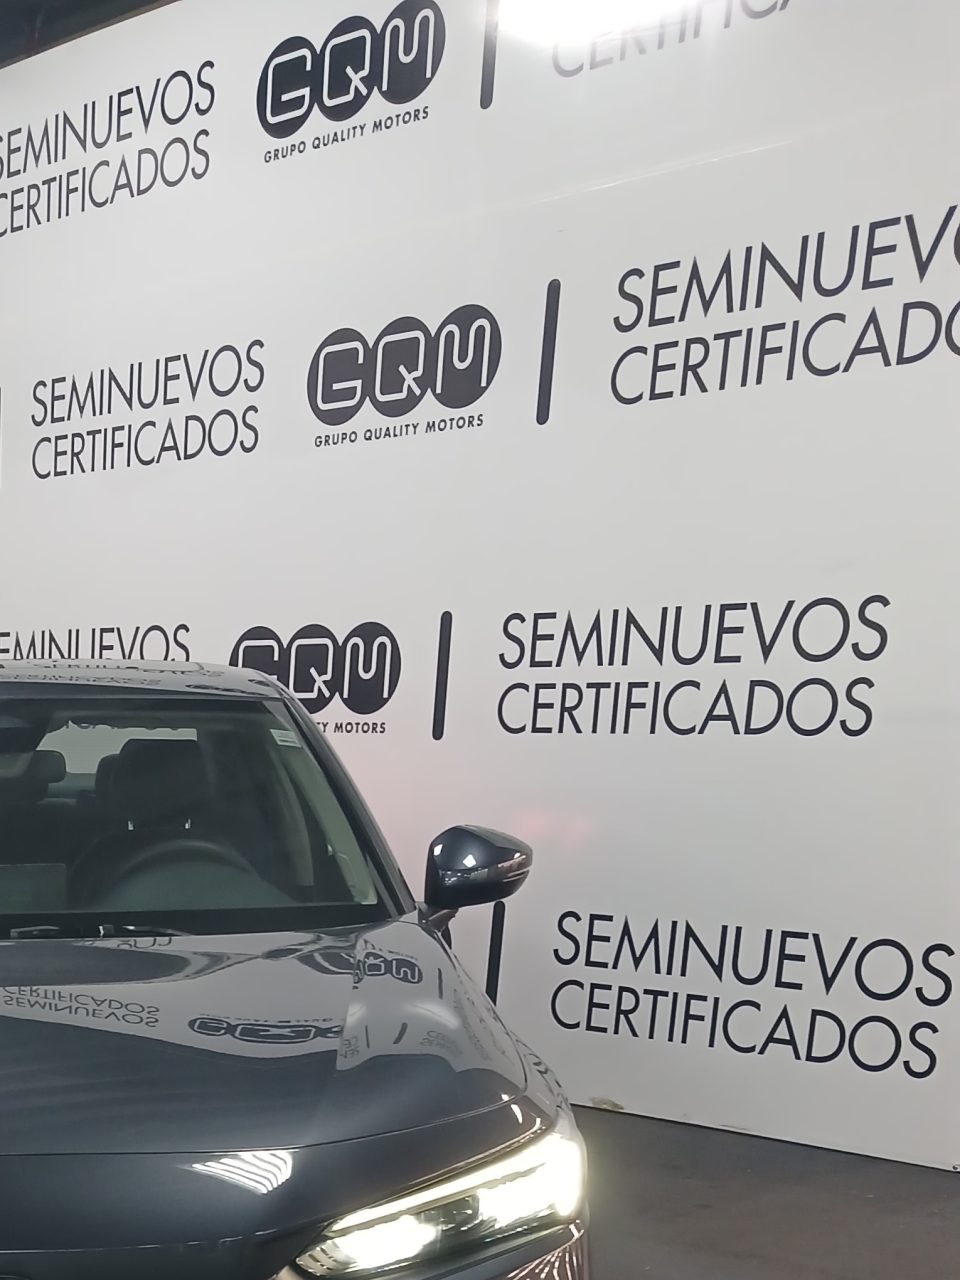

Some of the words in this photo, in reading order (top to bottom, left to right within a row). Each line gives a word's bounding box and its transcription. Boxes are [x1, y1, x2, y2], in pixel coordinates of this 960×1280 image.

[256, 0, 446, 139] GQM
[263, 140, 306, 163] GRUPO
[312, 123, 367, 149] QUALITY
[372, 105, 429, 133] MOTORS
[613, 204, 960, 334] SEMINUEV
[31, 339, 265, 428] SEMINUEVOS
[306, 304, 502, 427] GQM
[32, 404, 259, 480] CERTIFICADOS
[314, 430, 358, 447] GRUPO
[363, 422, 420, 441] QUALITY
[425, 414, 484, 433] MOTORS
[498, 594, 892, 670] SEMINUEVOS
[334, 722, 386, 734] MOTORS
[498, 676, 875, 738] CERTIFICADOS
[552, 910, 956, 1008] SEMINUEVOS
[550, 979, 940, 1080] CERTIFICADOS
